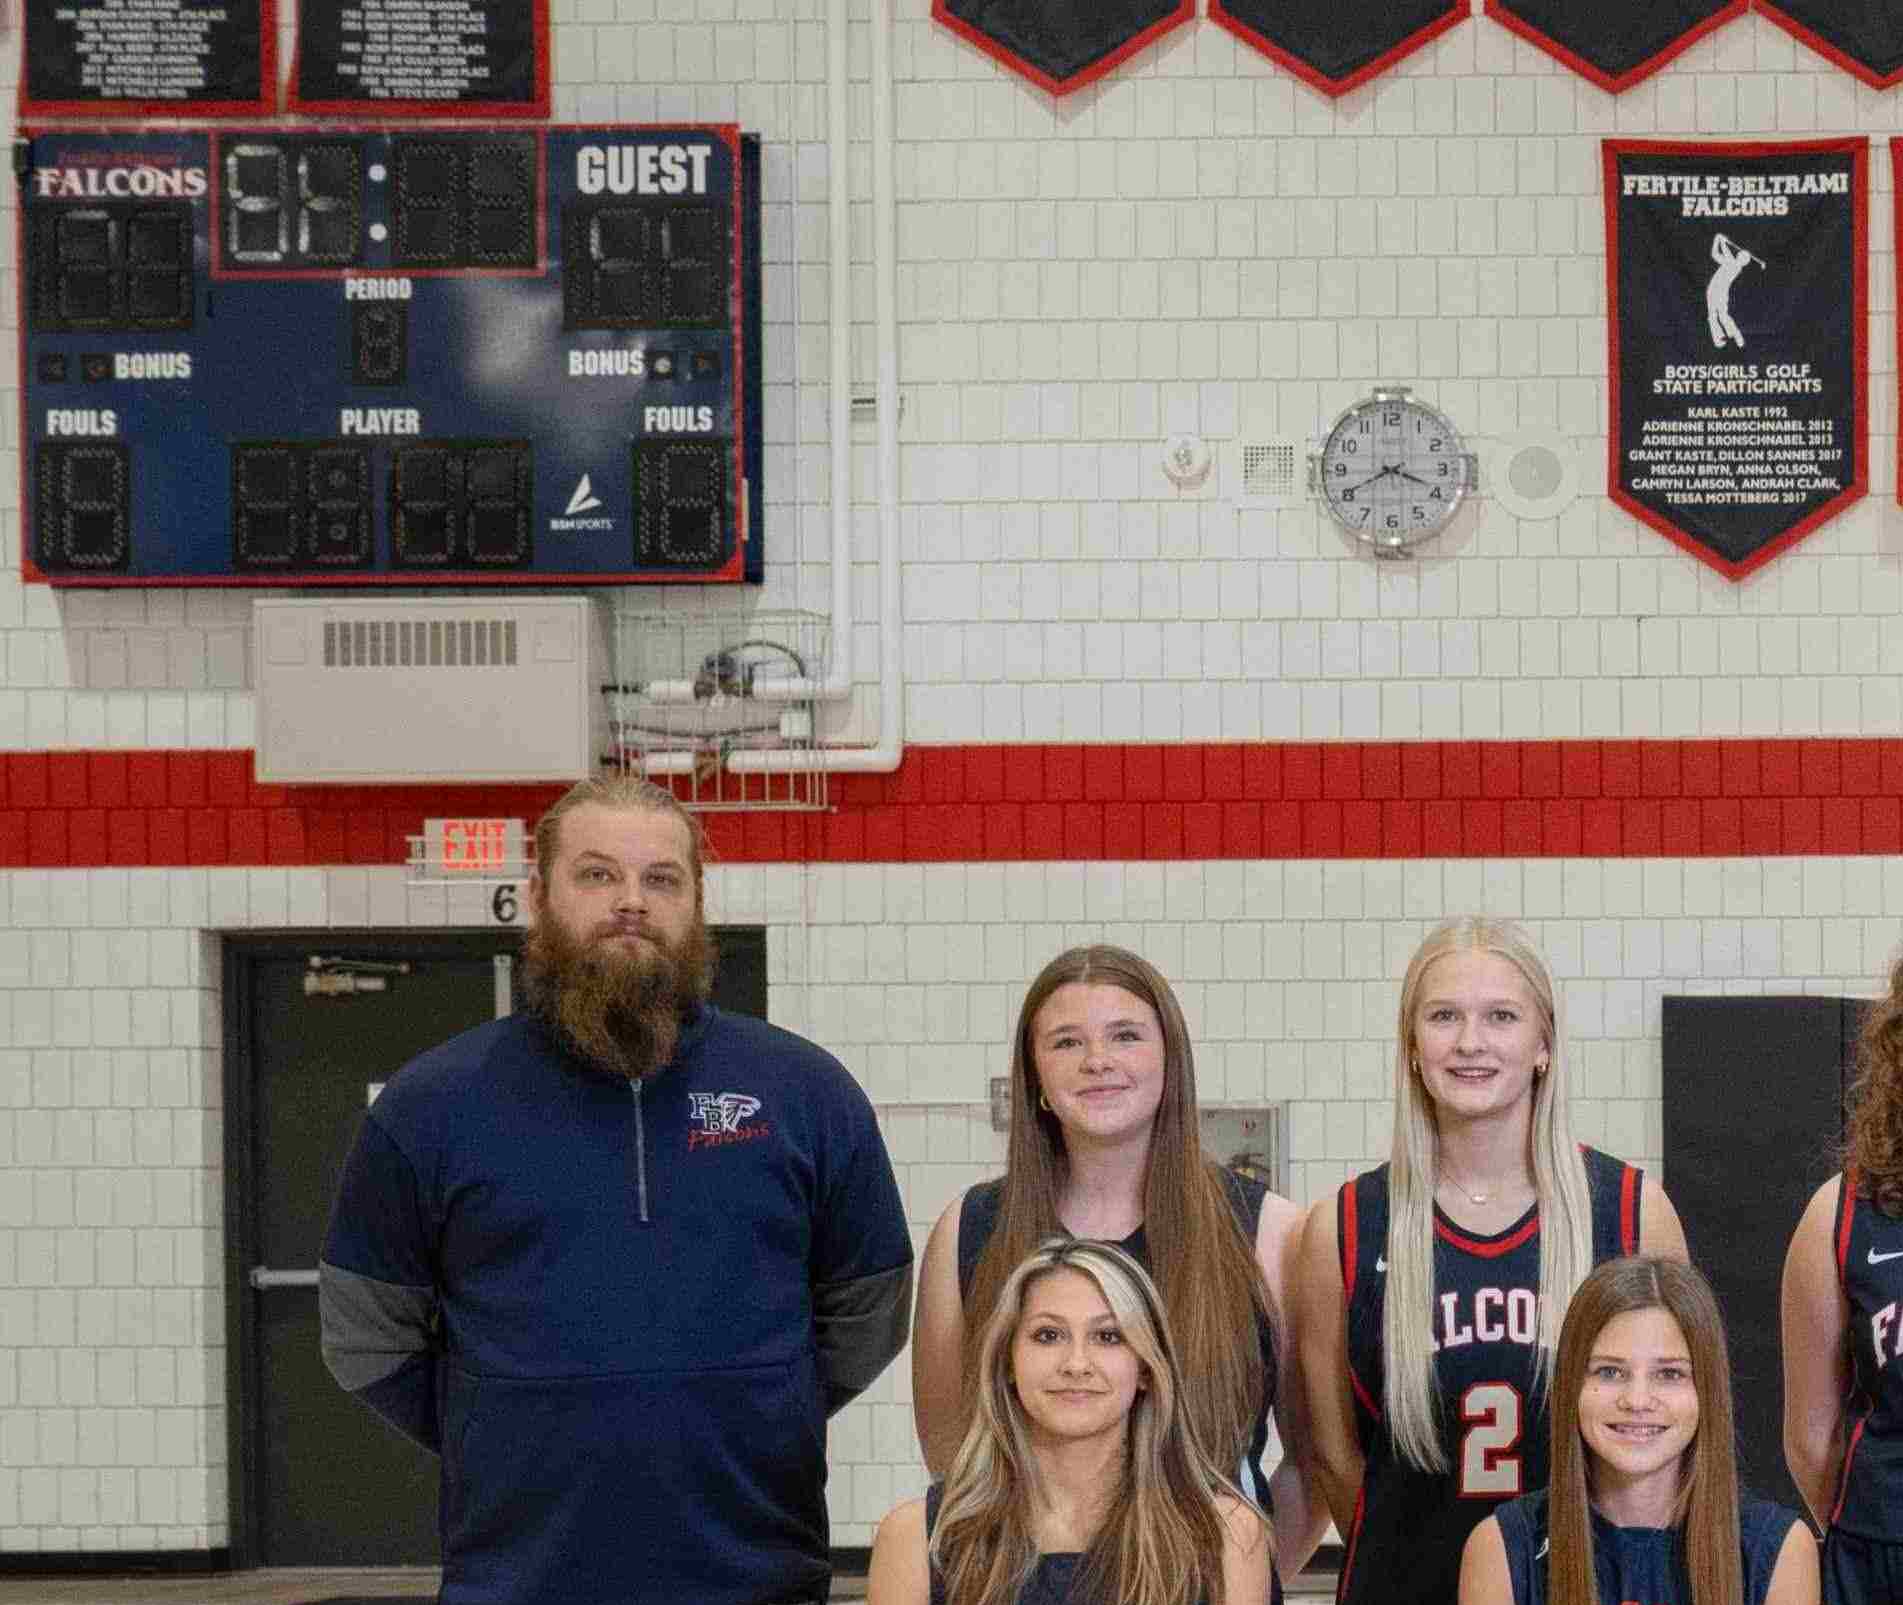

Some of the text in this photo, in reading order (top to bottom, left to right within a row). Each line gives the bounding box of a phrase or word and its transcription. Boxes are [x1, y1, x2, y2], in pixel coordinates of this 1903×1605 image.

[576, 145, 712, 194] GUEST
[35, 165, 208, 197] FALCONS
[1623, 173, 1848, 195] FERTILE-BELTRAMI
[1682, 196, 1789, 217] FALCONS
[345, 278, 412, 300] PERIOD
[114, 353, 192, 379] BONUS
[568, 350, 646, 376] BONUS
[1665, 364, 1811, 380] BOYS/GIRLS GOLF
[1653, 379, 1822, 394] STATE PARTICIPANTS
[644, 406, 713, 432] FOULS
[1382, 412, 1401, 427] 12
[1688, 407, 1761, 418] KARL KASTE
[47, 409, 118, 435] FOULS
[341, 408, 420, 435] PLAYER
[1359, 420, 1369, 434] 11
[1642, 421, 1704, 432] ADRIENNE
[1341, 439, 1357, 454] 10
[1430, 438, 1442, 452] 2
[1642, 435, 1704, 446] ADRIENNE
[1629, 450, 1672, 462] GRANT
[1335, 463, 1347, 477] 9
[1437, 463, 1448, 477] 3
[1342, 488, 1355, 501] 8
[1429, 486, 1442, 500] 4
[1360, 507, 1371, 521] 7
[1412, 506, 1425, 520] 5
[1386, 515, 1399, 528] 6
[443, 821, 505, 869] EXIT
[493, 884, 518, 923] 6
[1456, 1380, 1523, 1499] 2
